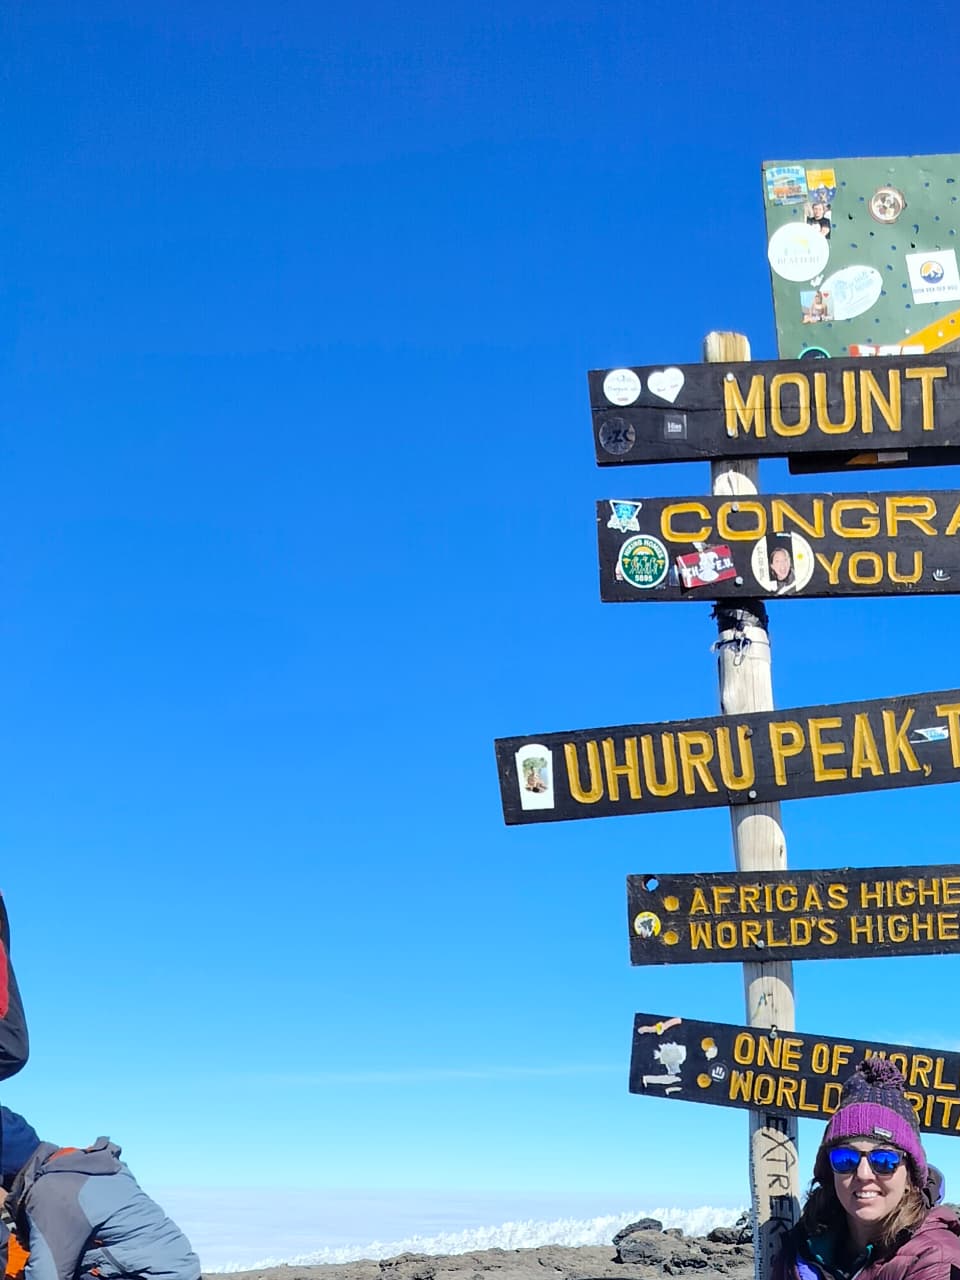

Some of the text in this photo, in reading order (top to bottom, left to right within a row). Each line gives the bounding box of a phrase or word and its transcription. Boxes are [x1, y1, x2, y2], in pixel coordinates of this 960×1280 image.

[724, 366, 947, 439] MOUNT
[815, 550, 924, 585] YOU
[563, 724, 756, 805] UHURU
[767, 707, 932, 786] PEAK,
[689, 916, 839, 951] WORLD'S
[733, 1031, 805, 1073] ONE
[810, 1042, 855, 1077] OF
